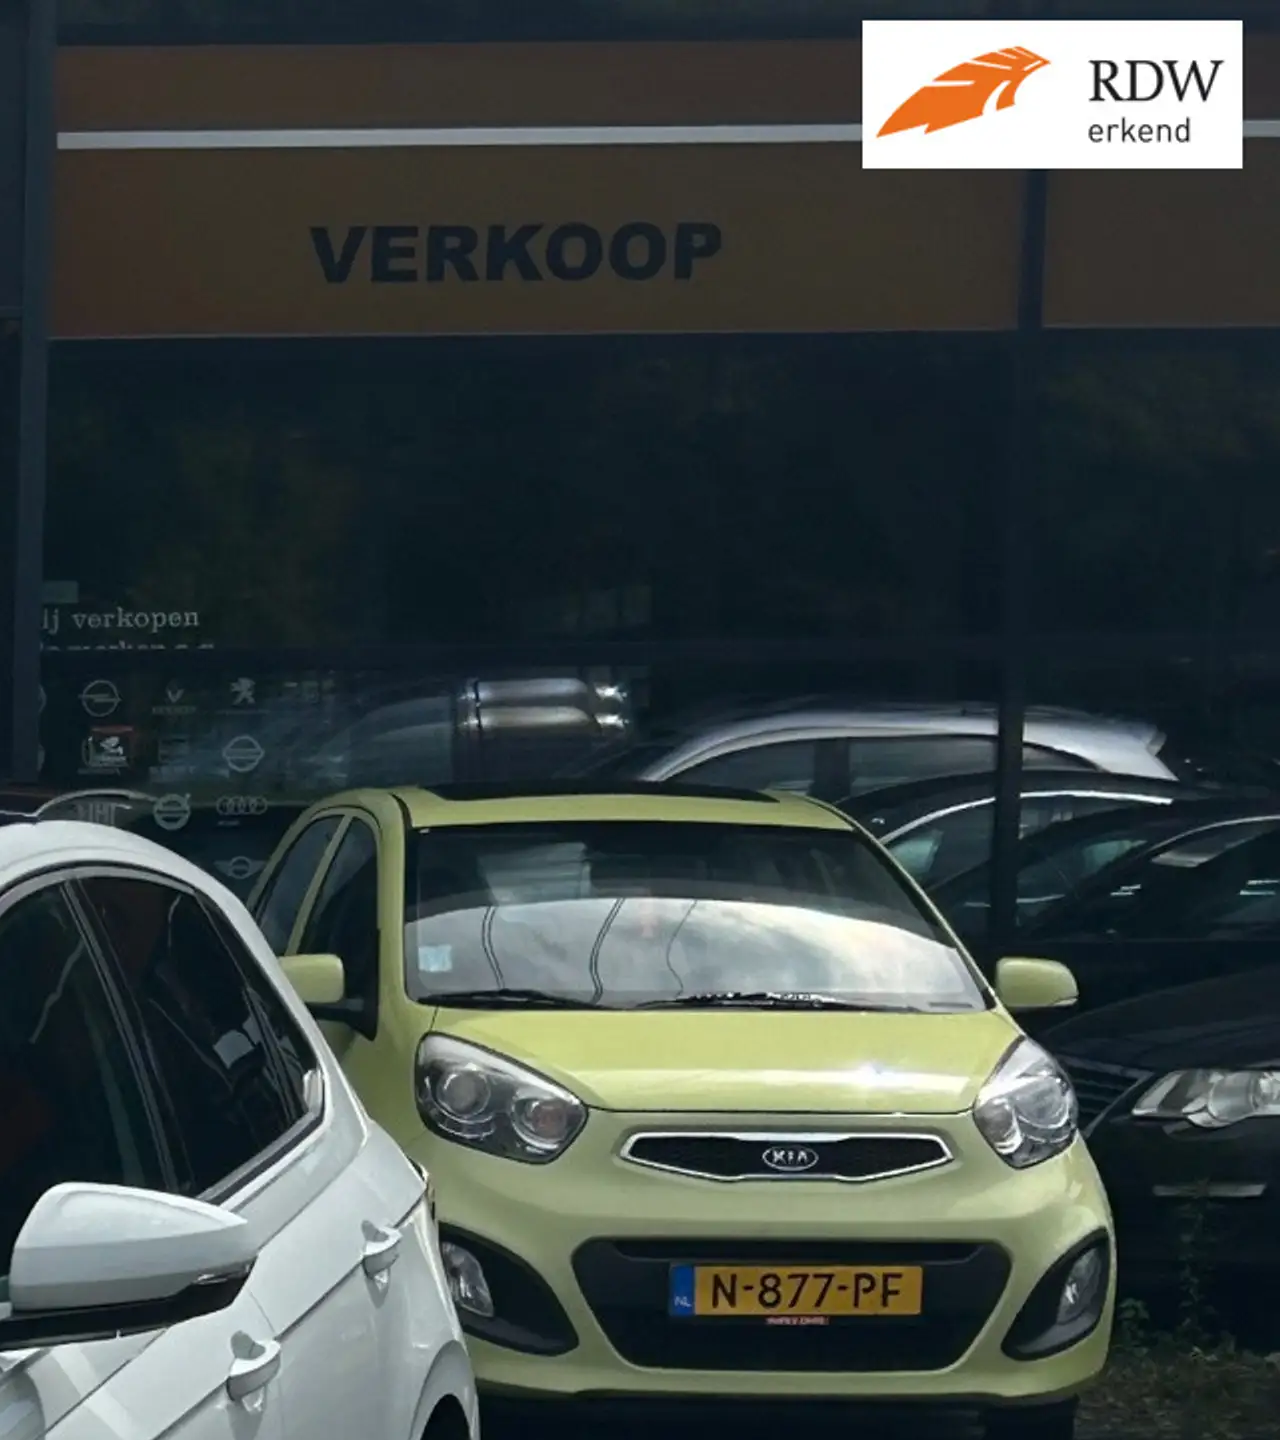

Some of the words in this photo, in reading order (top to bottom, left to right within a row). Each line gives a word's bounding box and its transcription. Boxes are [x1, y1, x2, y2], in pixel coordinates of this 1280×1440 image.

[309, 221, 722, 283] VERKOOP
[72, 606, 200, 634] verkopen
[772, 1149, 809, 1164] KIA
[711, 1273, 903, 1309] N-877-PF
